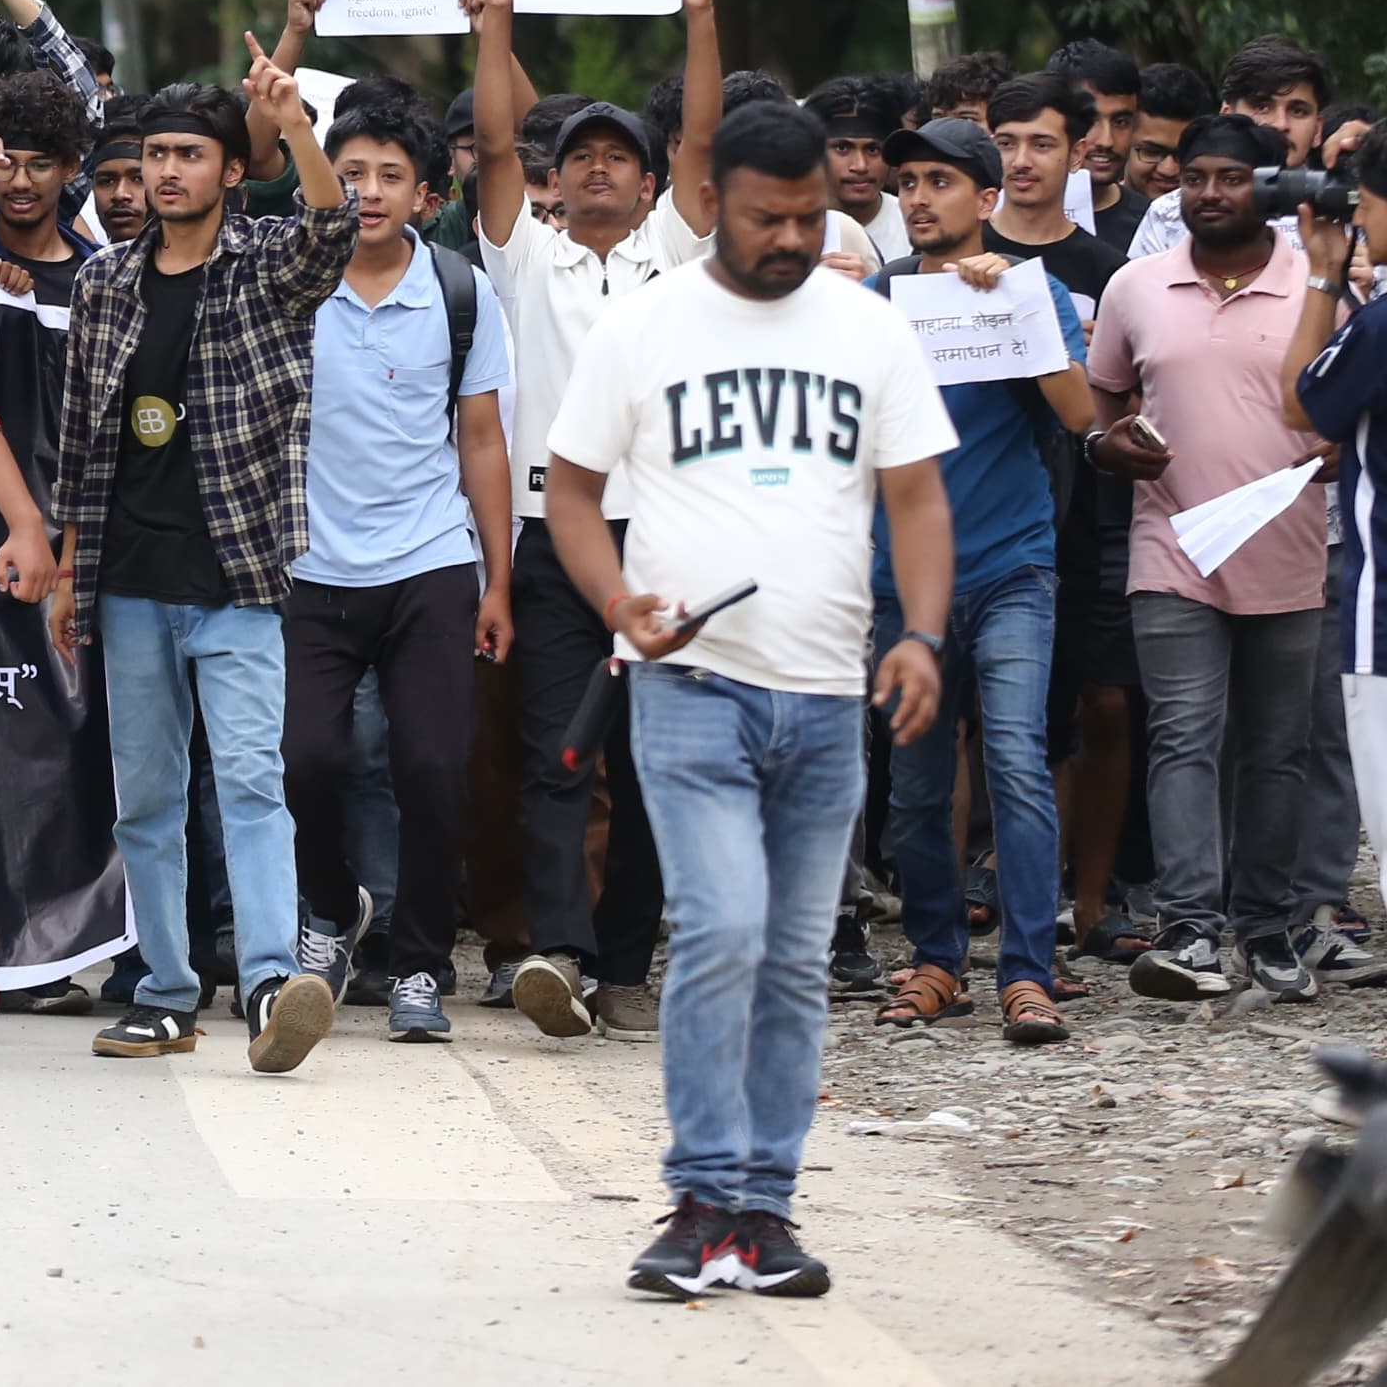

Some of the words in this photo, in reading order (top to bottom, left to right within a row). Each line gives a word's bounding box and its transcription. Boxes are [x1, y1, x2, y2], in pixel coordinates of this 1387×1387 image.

[347, 7, 398, 19] freedom,
[971, 311, 1014, 332] होइन
[931, 343, 1003, 363] समाधान
[1011, 338, 1028, 358] दे!
[665, 368, 862, 468] LEVI'S
